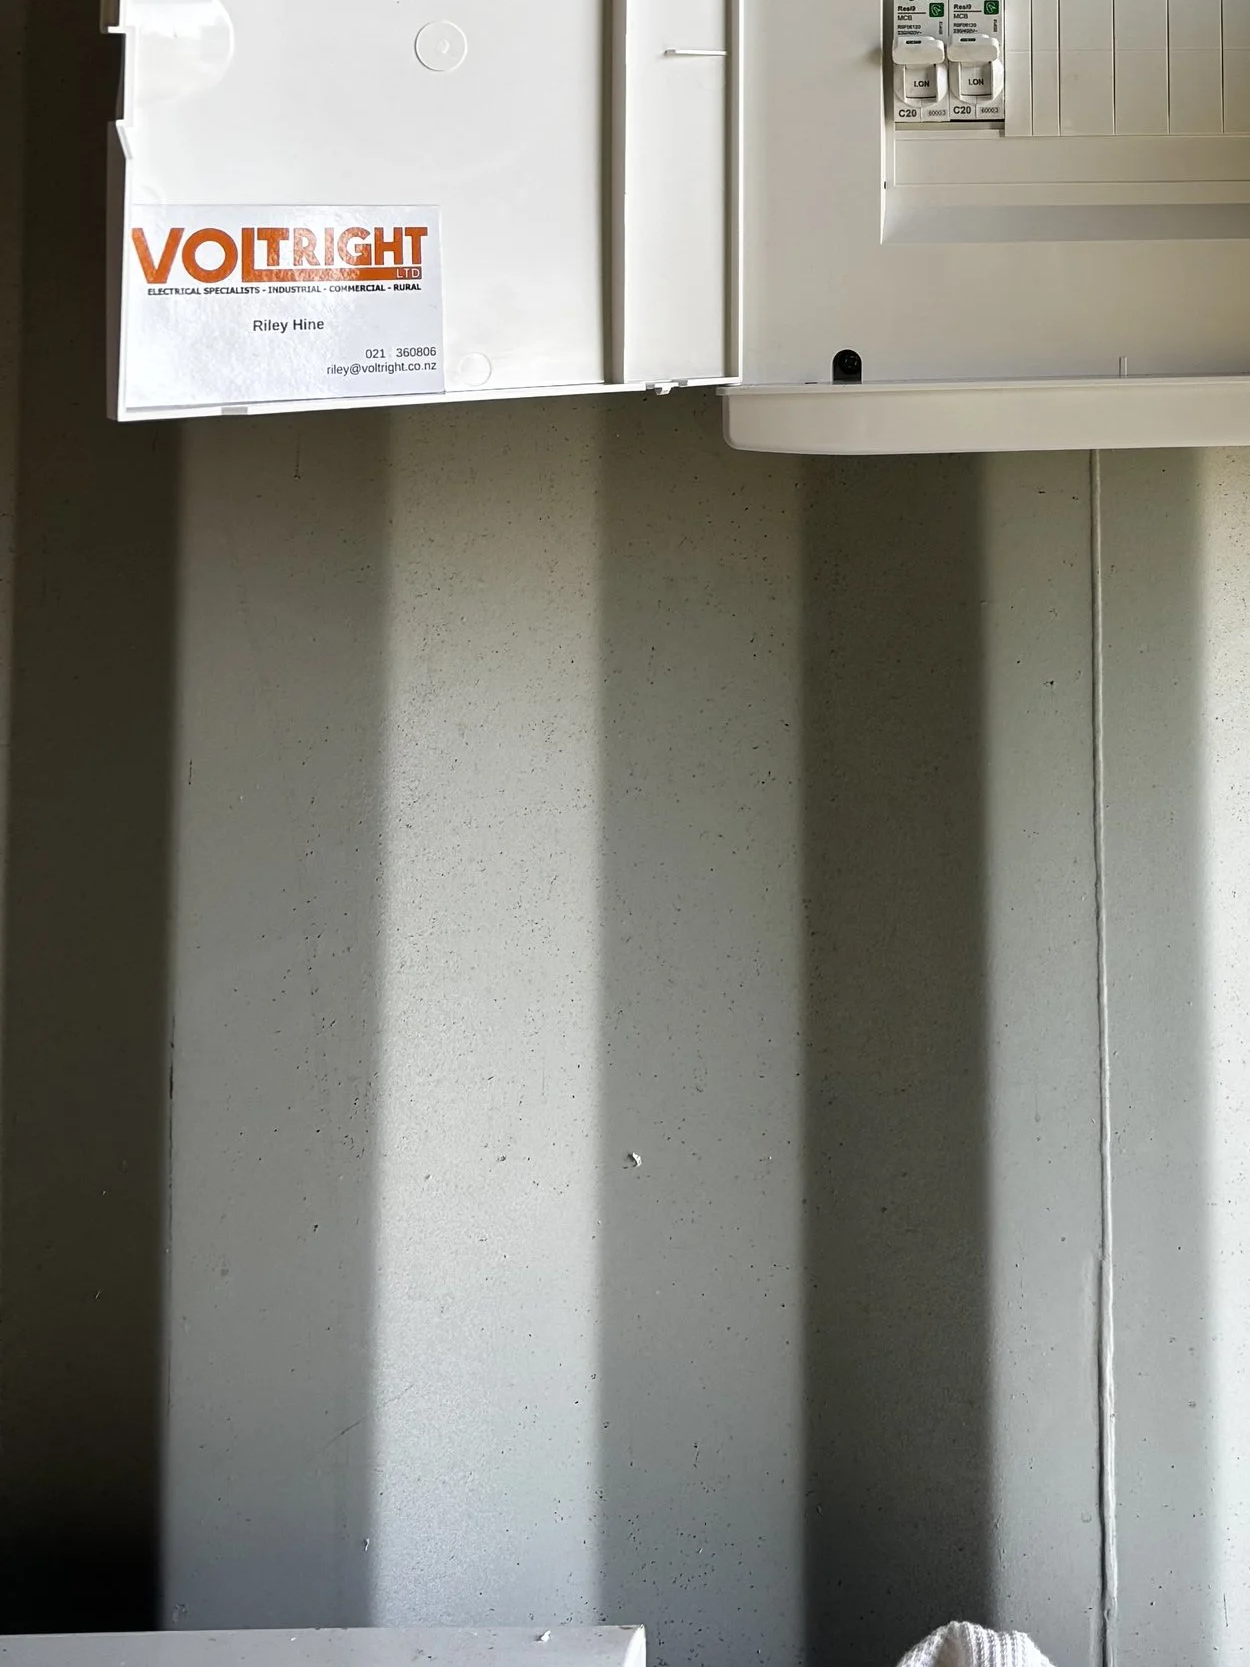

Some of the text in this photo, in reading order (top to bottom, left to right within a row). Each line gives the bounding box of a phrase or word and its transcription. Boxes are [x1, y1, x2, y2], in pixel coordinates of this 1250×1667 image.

[898, 109, 917, 118] C20
[953, 106, 971, 114] C20
[131, 227, 428, 284] VOLTRIGHT
[396, 268, 420, 278] LTD
[148, 288, 202, 296] ELECTRICAL
[204, 286, 260, 294] SPECIALISTS
[268, 286, 321, 294] INDUSTRIAL
[329, 284, 386, 292] COMMERCIAL
[394, 284, 422, 292] RURAL
[252, 318, 324, 334] Riley Hine
[366, 346, 437, 359] 021 360806
[326, 362, 437, 377] riley@voltright.co.nz
